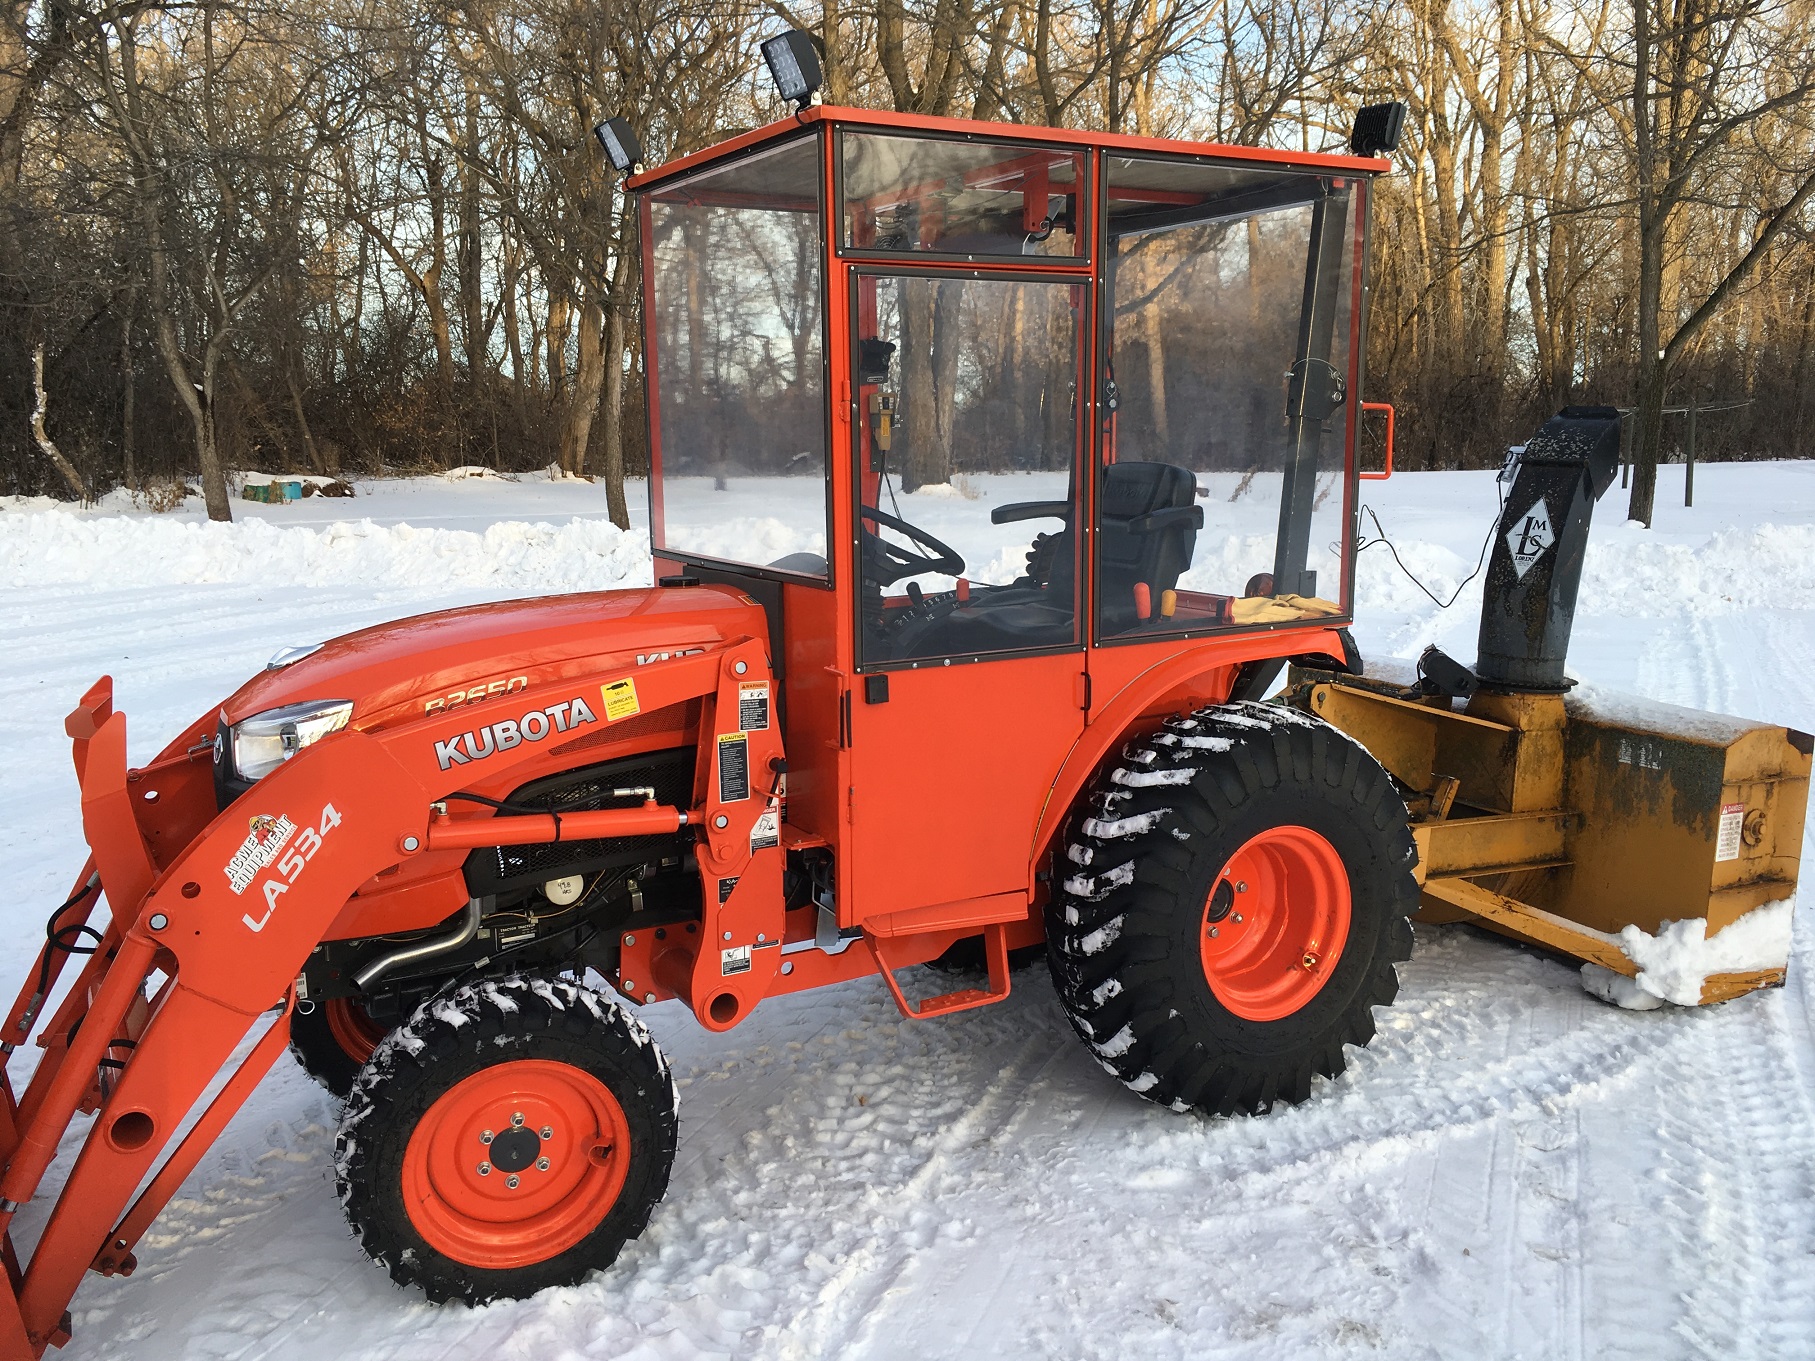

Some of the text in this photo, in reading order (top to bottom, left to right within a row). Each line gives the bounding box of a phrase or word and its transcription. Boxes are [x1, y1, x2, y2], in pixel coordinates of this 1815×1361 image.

[608, 695, 633, 706] LUBRICATE
[433, 696, 598, 771] KUBOTA
[724, 733, 746, 741] CAUTION
[225, 836, 260, 880] ACME
[232, 813, 293, 894] EQUIPMENT
[241, 802, 343, 933] LA534
